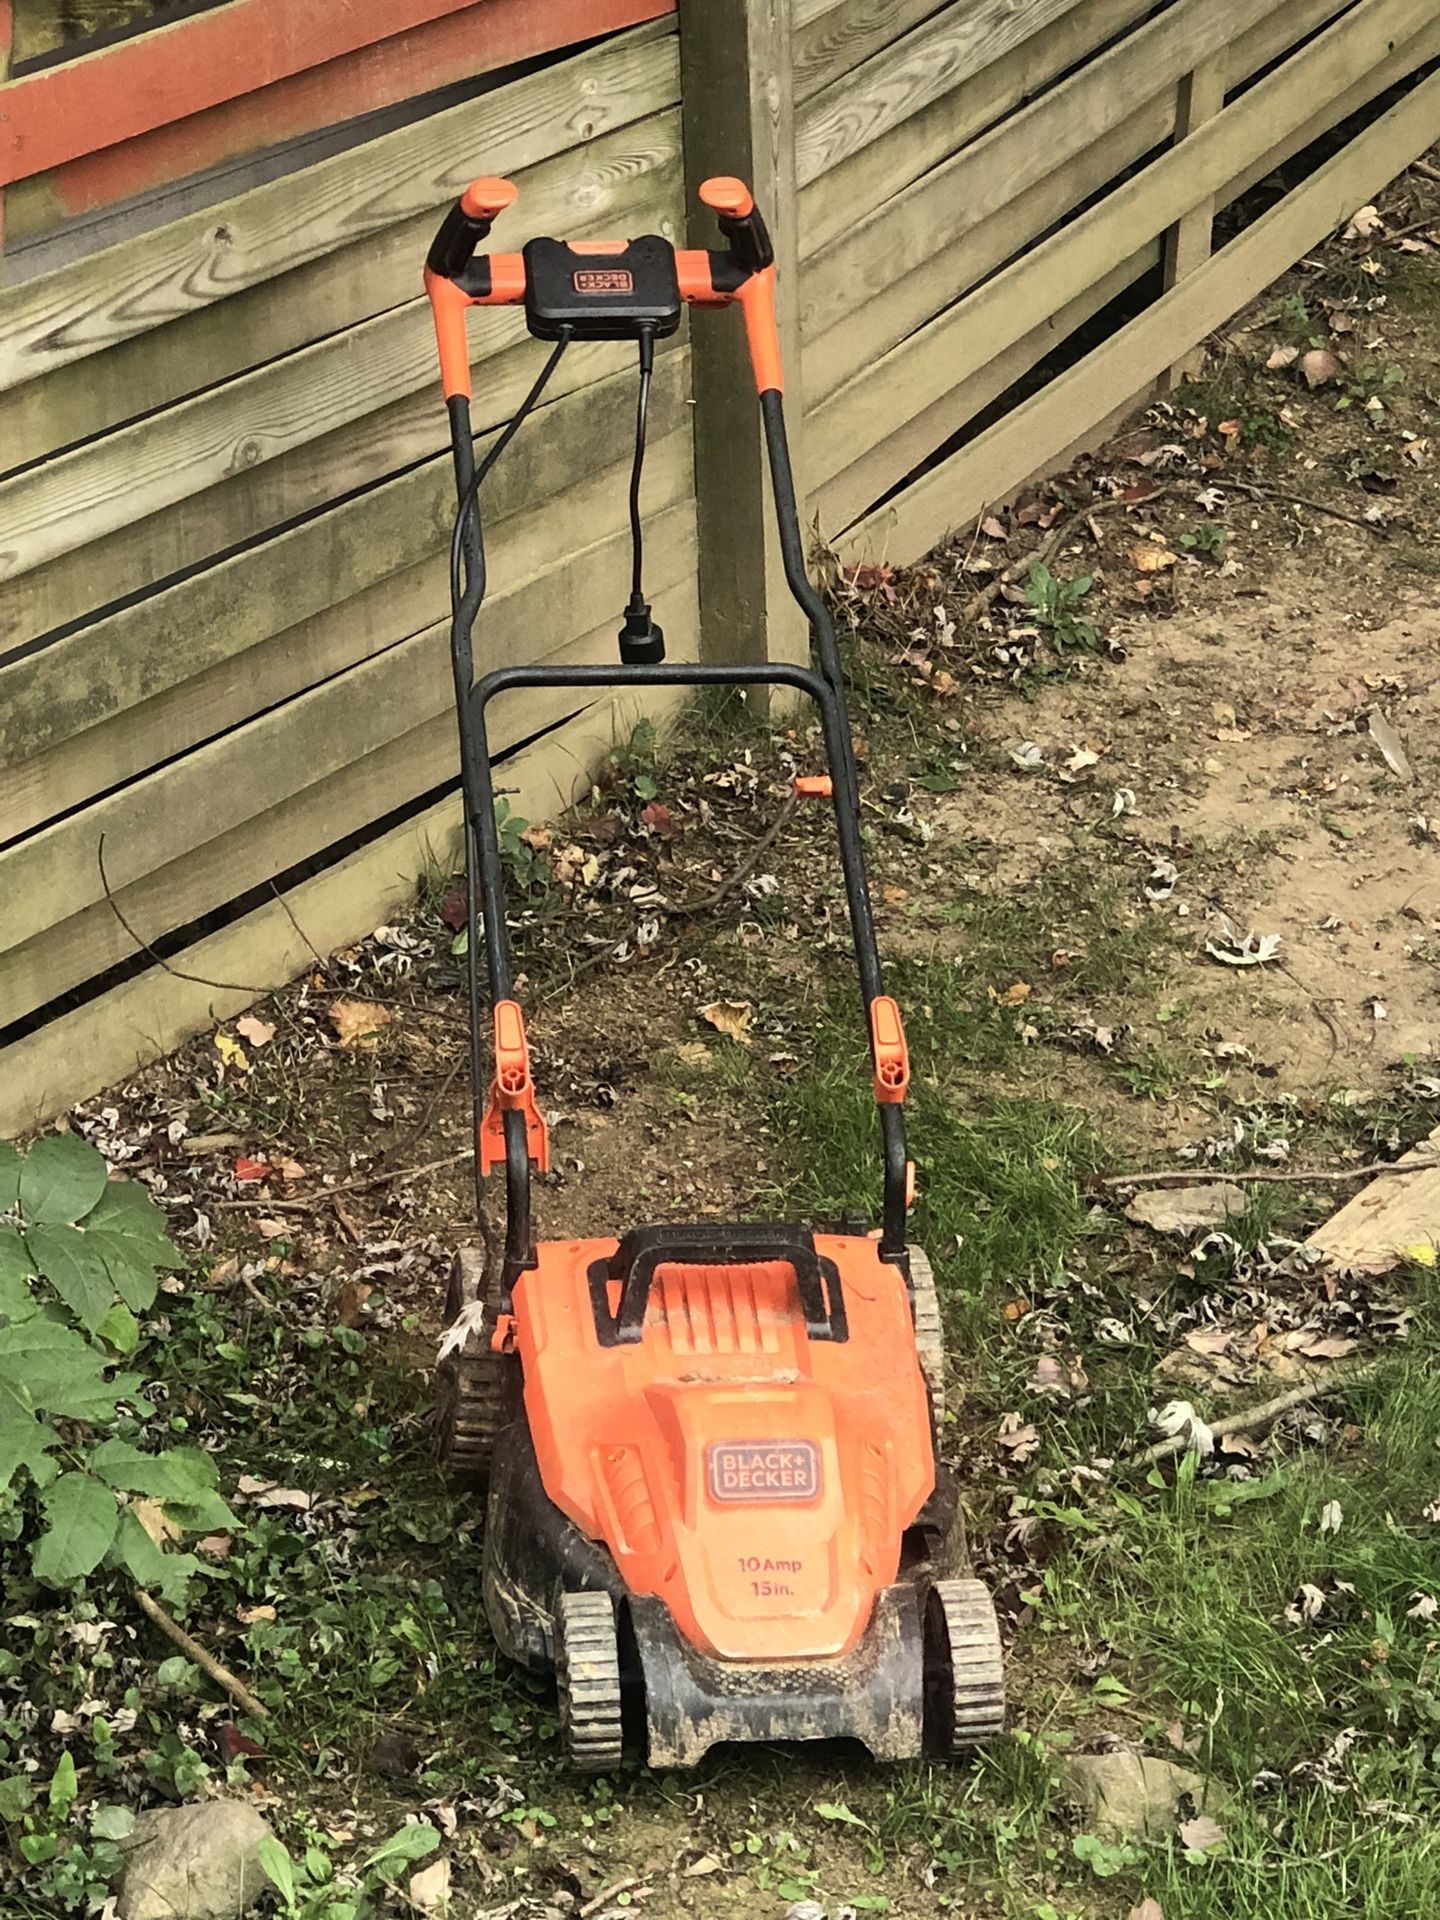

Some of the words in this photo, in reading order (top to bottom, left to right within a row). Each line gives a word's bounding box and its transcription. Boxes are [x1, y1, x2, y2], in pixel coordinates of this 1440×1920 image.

[580, 281, 629, 289] BLACK+
[722, 1453, 805, 1470] BLACK+
[723, 1470, 807, 1488] DECKER
